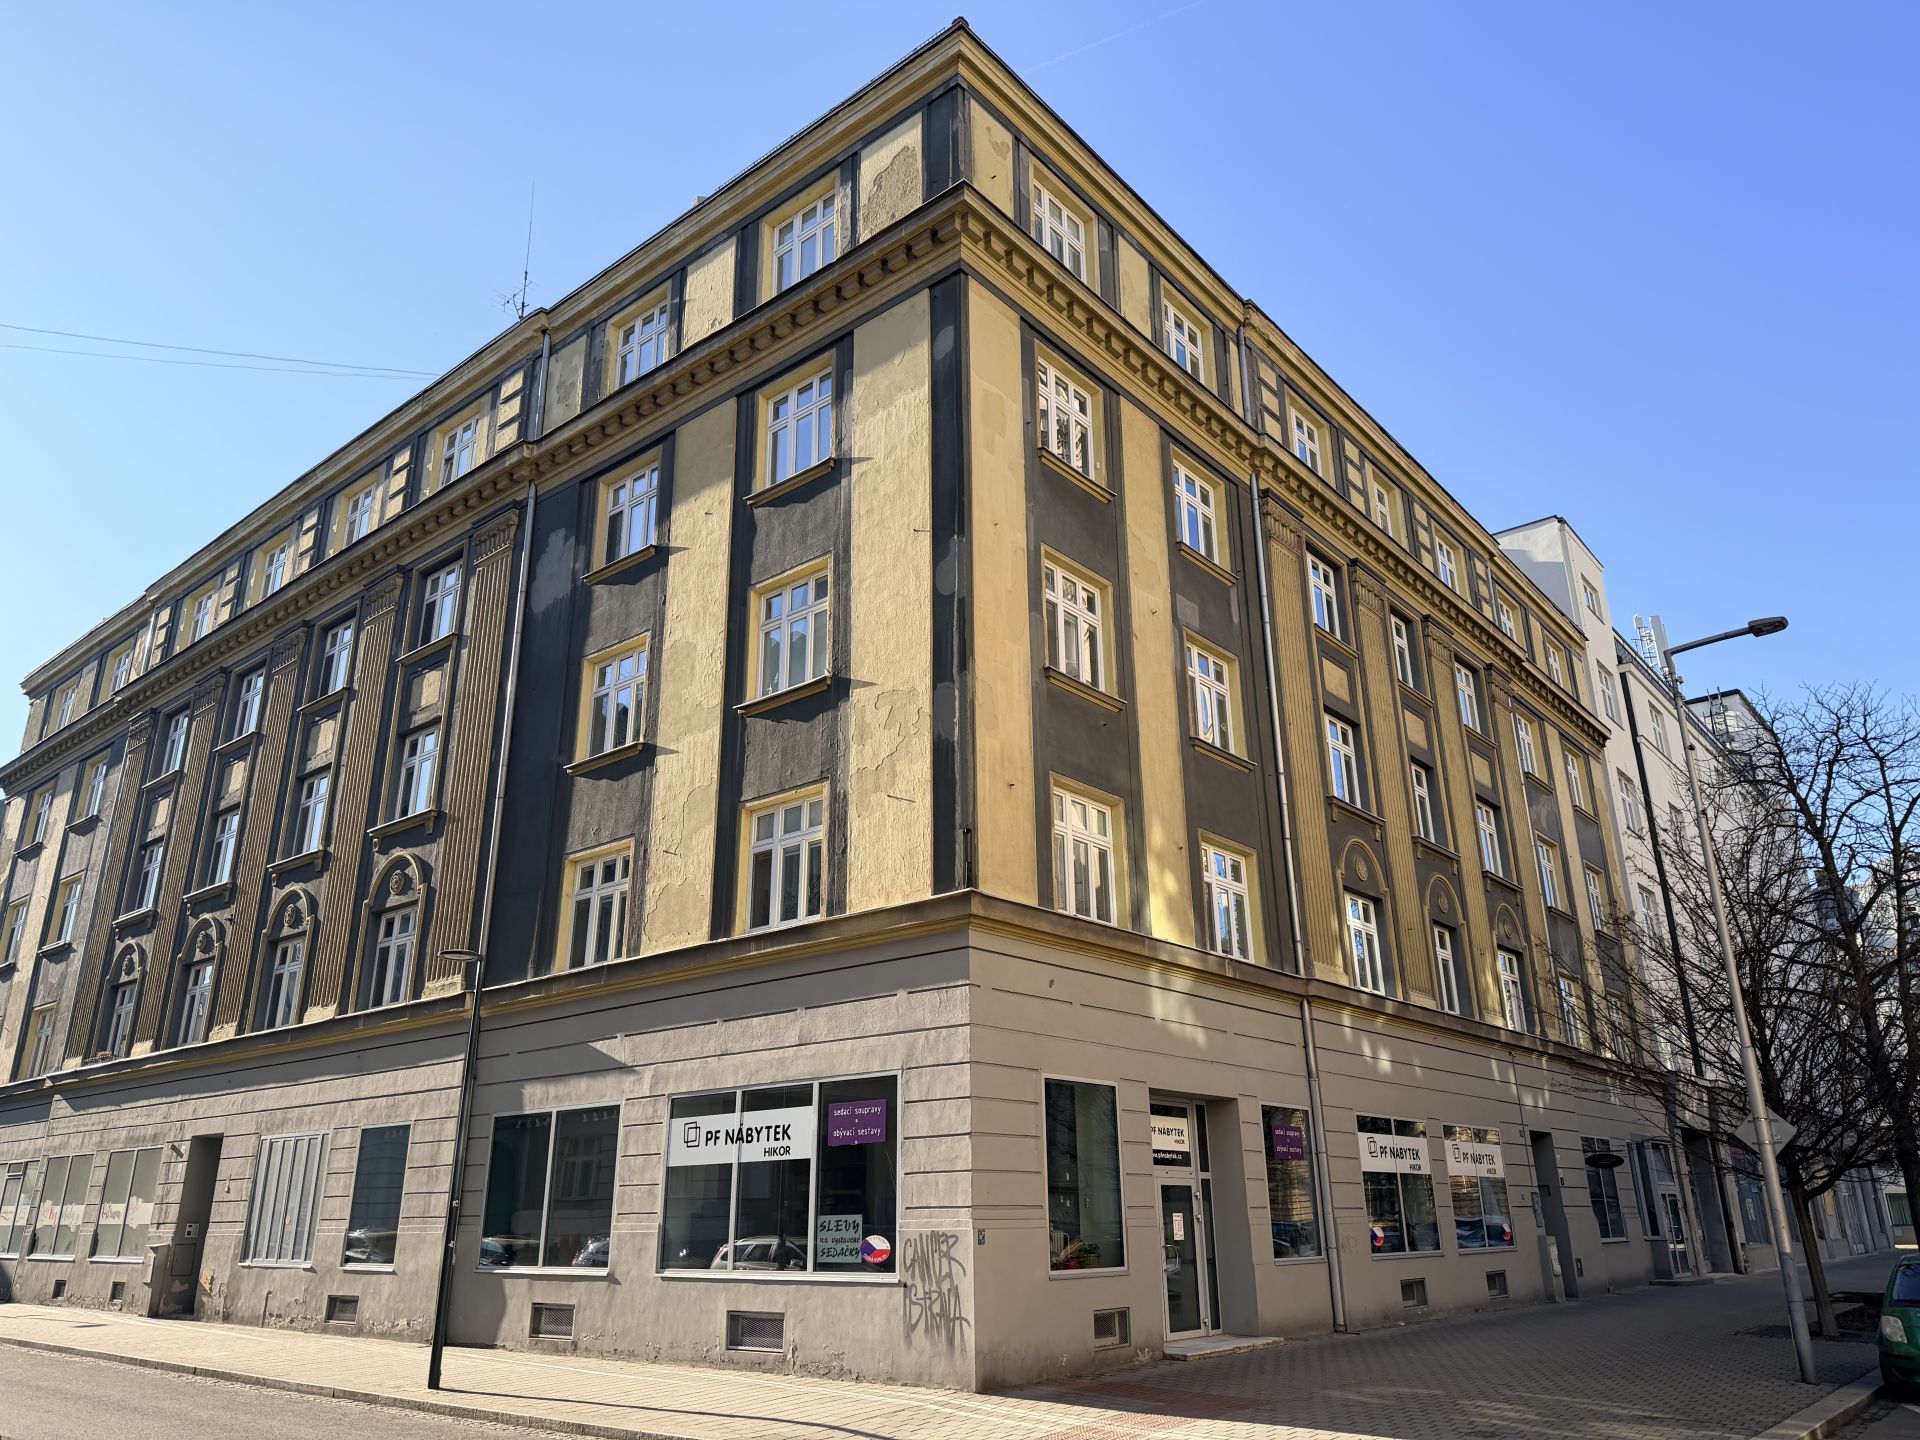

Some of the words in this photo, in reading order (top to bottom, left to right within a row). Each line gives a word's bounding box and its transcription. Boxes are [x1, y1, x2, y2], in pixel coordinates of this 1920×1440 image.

[833, 1106, 852, 1116] sedací
[854, 1106, 881, 1116] soupravy
[705, 1130, 721, 1147] PF
[724, 1122, 791, 1145] NÁBYTEK
[857, 1127, 881, 1137] sestavy
[763, 1146, 791, 1157] HIKOR
[1379, 1145, 1388, 1159] PF
[1389, 1143, 1421, 1161] NÁBYTEK
[1462, 1151, 1470, 1164] PF
[819, 1219, 860, 1234] SLEVY
[820, 1245, 860, 1259] SEDAČKY
